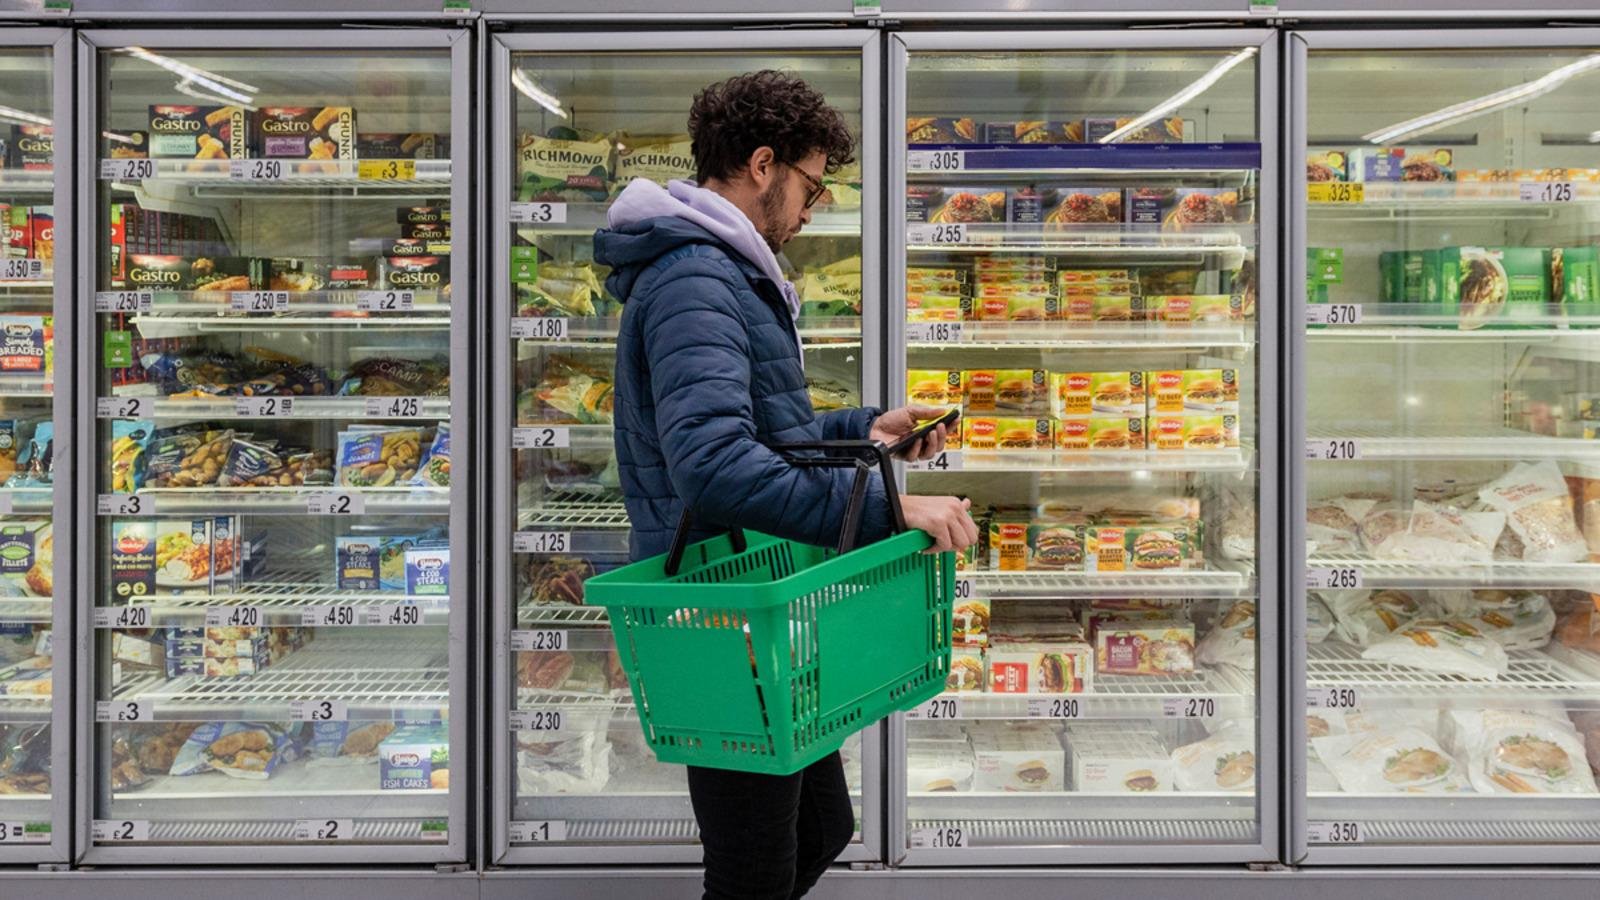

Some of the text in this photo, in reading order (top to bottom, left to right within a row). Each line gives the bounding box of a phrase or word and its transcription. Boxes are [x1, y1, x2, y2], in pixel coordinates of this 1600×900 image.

[152, 117, 201, 130] Gastro
[262, 119, 310, 132] Gastro
[232, 111, 242, 158] CHUNK
[341, 112, 350, 158] CHUNK
[523, 150, 603, 164] RICHMOND
[382, 161, 398, 178] £3
[531, 204, 552, 222] £3
[393, 245, 423, 253] Gastro
[130, 268, 181, 283] Gastro
[390, 271, 440, 284] Gastro
[380, 292, 396, 309] £2
[119, 398, 140, 417] £2
[260, 398, 276, 416] £2
[534, 429, 555, 447] £2
[928, 452, 949, 470] £4
[120, 496, 140, 514] £3
[330, 495, 351, 513] £2
[118, 702, 139, 720] £3
[312, 701, 332, 720] £3
[383, 778, 429, 788] FISH CAKES
[113, 822, 134, 839] £2
[318, 820, 338, 839] £2
[531, 822, 549, 840] £1
